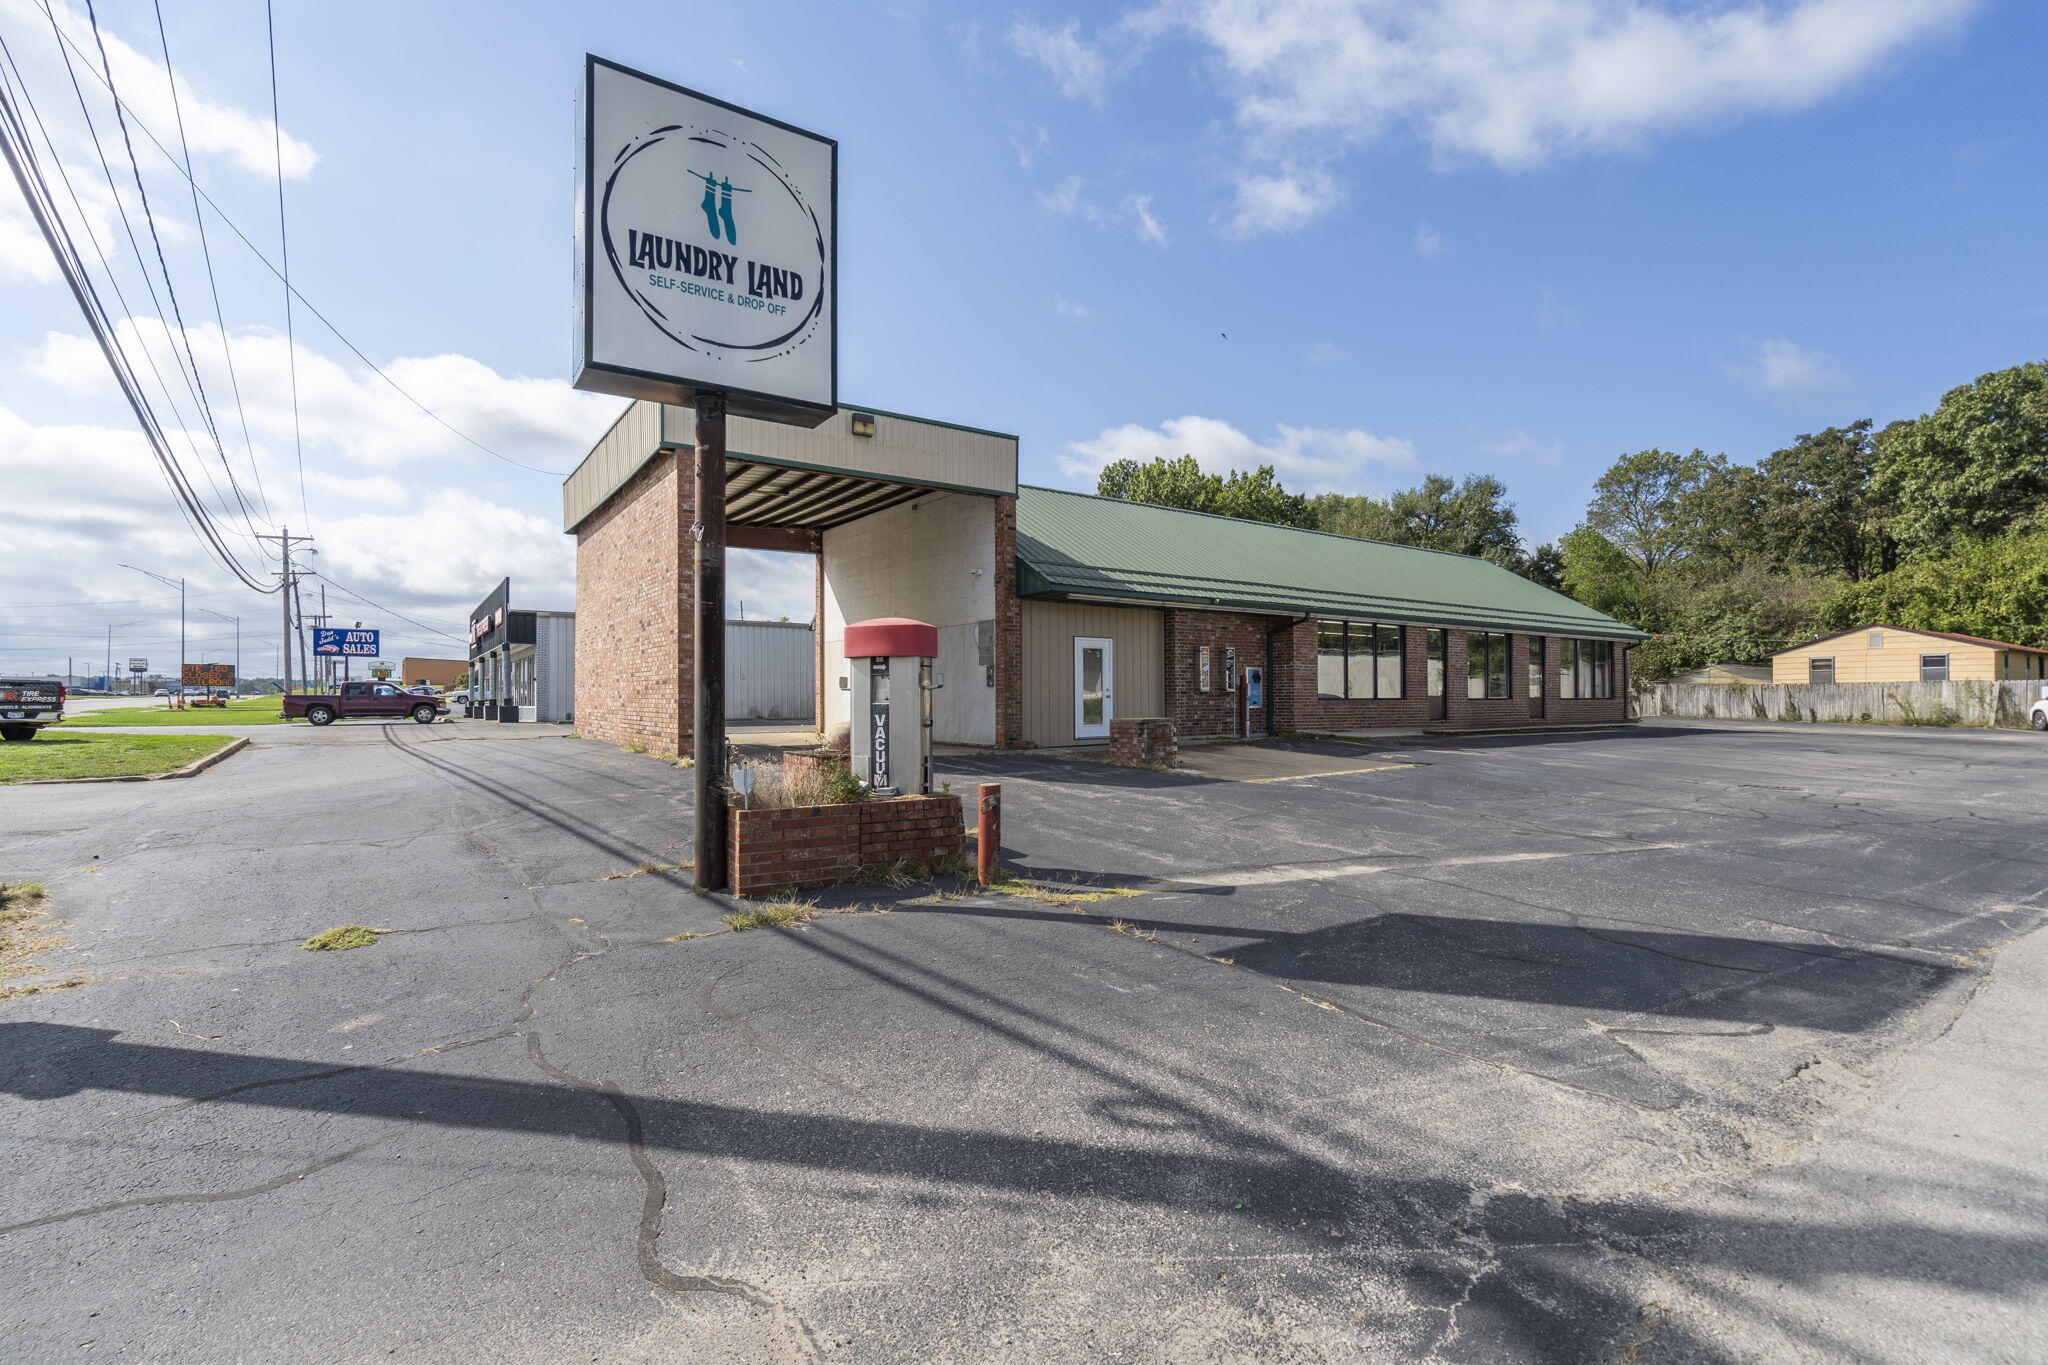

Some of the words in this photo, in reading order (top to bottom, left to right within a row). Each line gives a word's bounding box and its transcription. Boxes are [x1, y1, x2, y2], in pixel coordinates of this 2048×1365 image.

[628, 228, 738, 285] LAUNDRY
[747, 260, 803, 301] LAND
[649, 274, 725, 302] SELF-SERVICE
[727, 293, 735, 305] &
[737, 295, 765, 313] DROP
[767, 302, 787, 316] OFF
[345, 631, 374, 643] AUTO
[342, 643, 377, 655] SALES
[182, 671, 222, 679] CLOSED
[182, 678, 234, 686] RAILROAD
[873, 714, 888, 787] VACUUM
